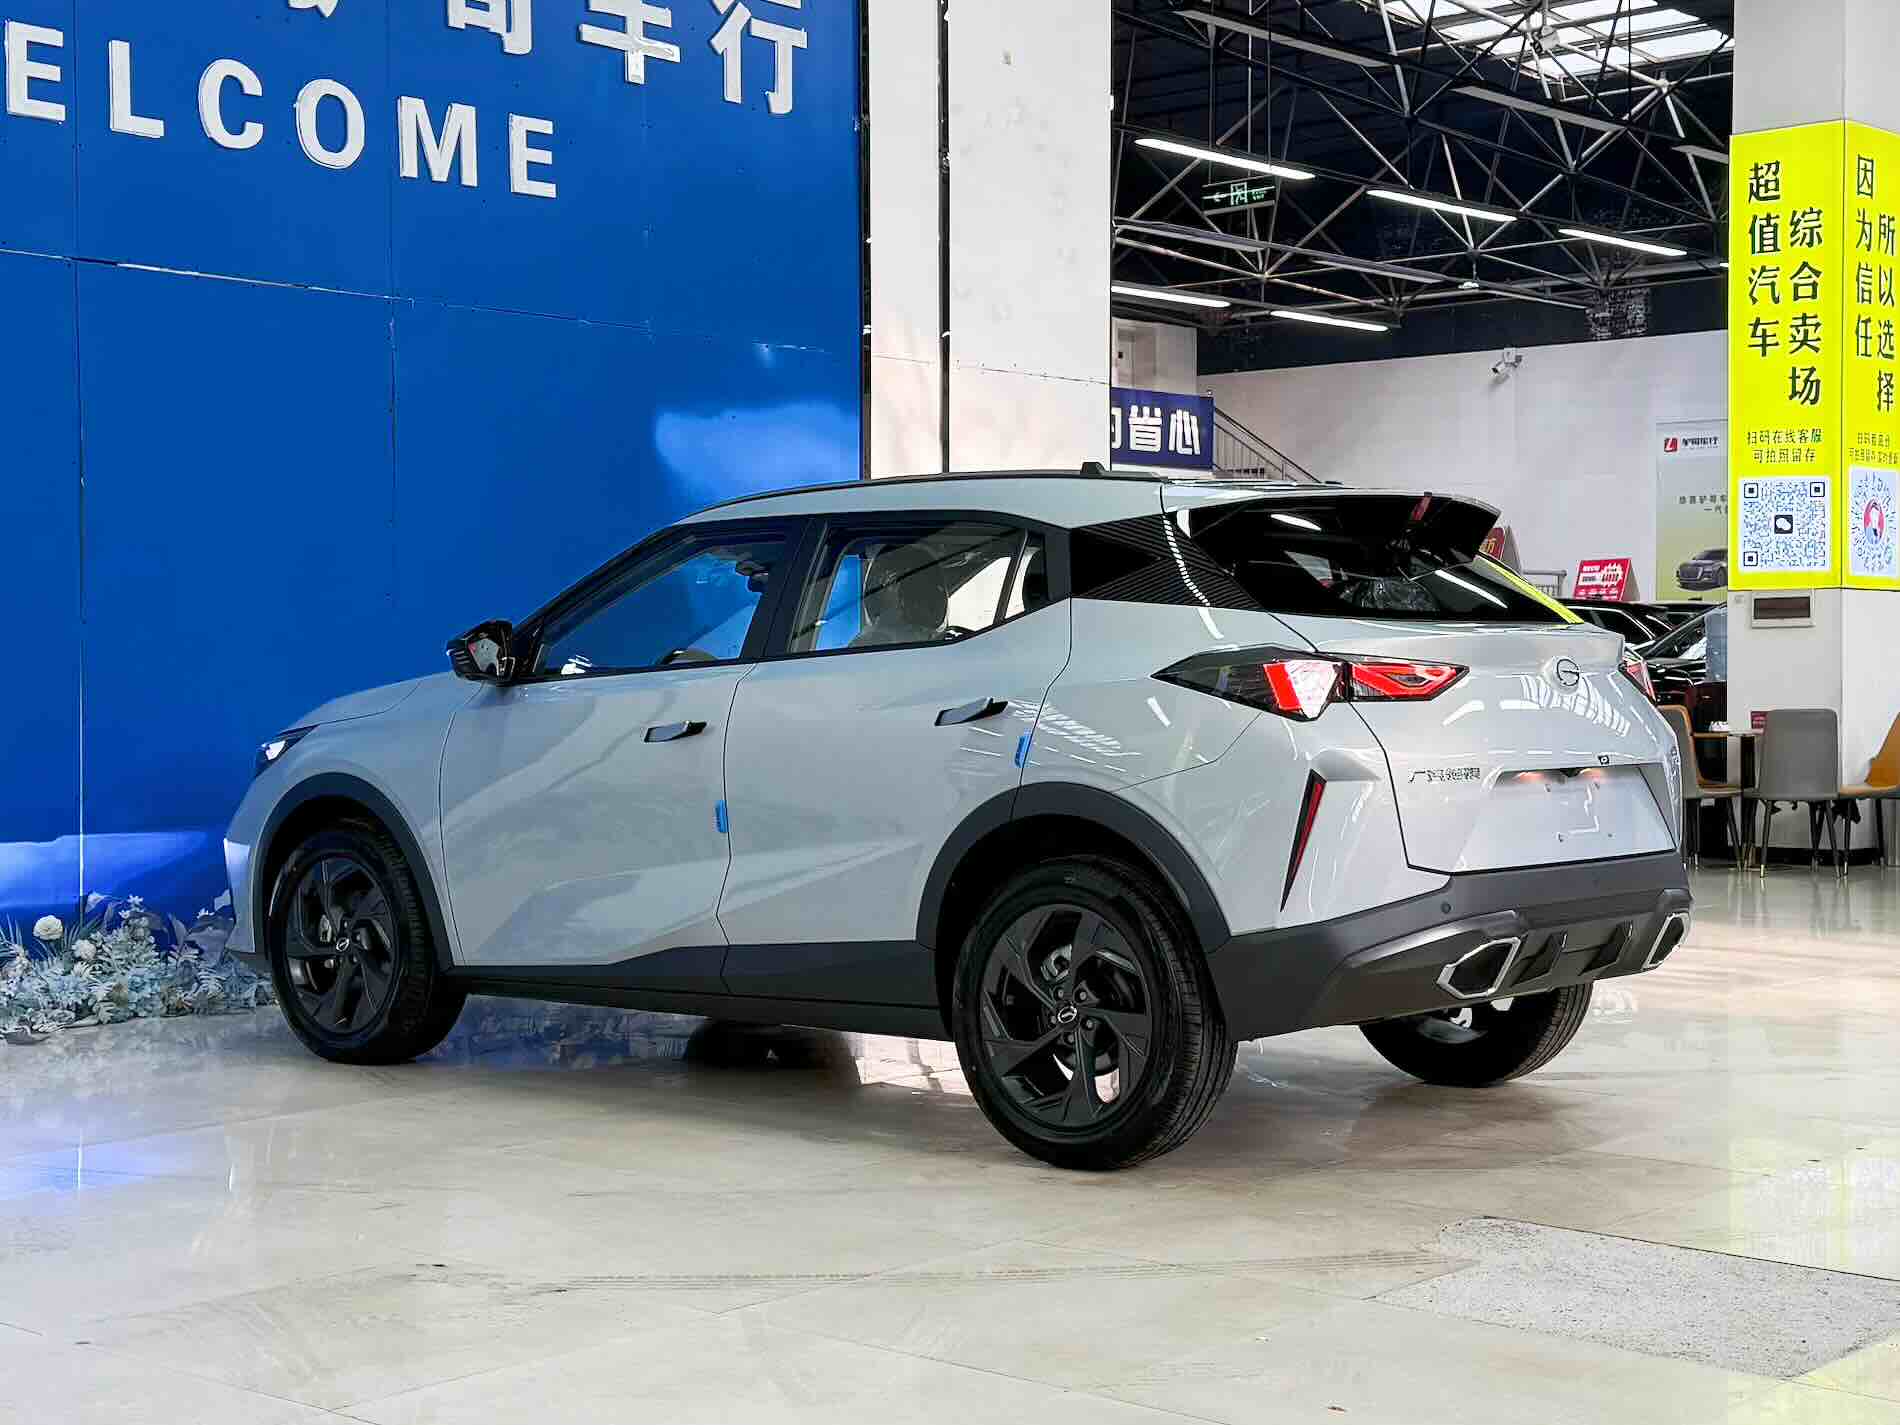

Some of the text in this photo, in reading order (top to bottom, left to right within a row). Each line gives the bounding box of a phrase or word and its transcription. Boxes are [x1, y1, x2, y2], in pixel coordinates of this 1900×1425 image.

[1748, 160, 1781, 357] 超值汽车
[1788, 206, 1824, 405] 综合卖场
[1855, 154, 1874, 358] 因为信任
[1877, 212, 1896, 413] 所以选择
